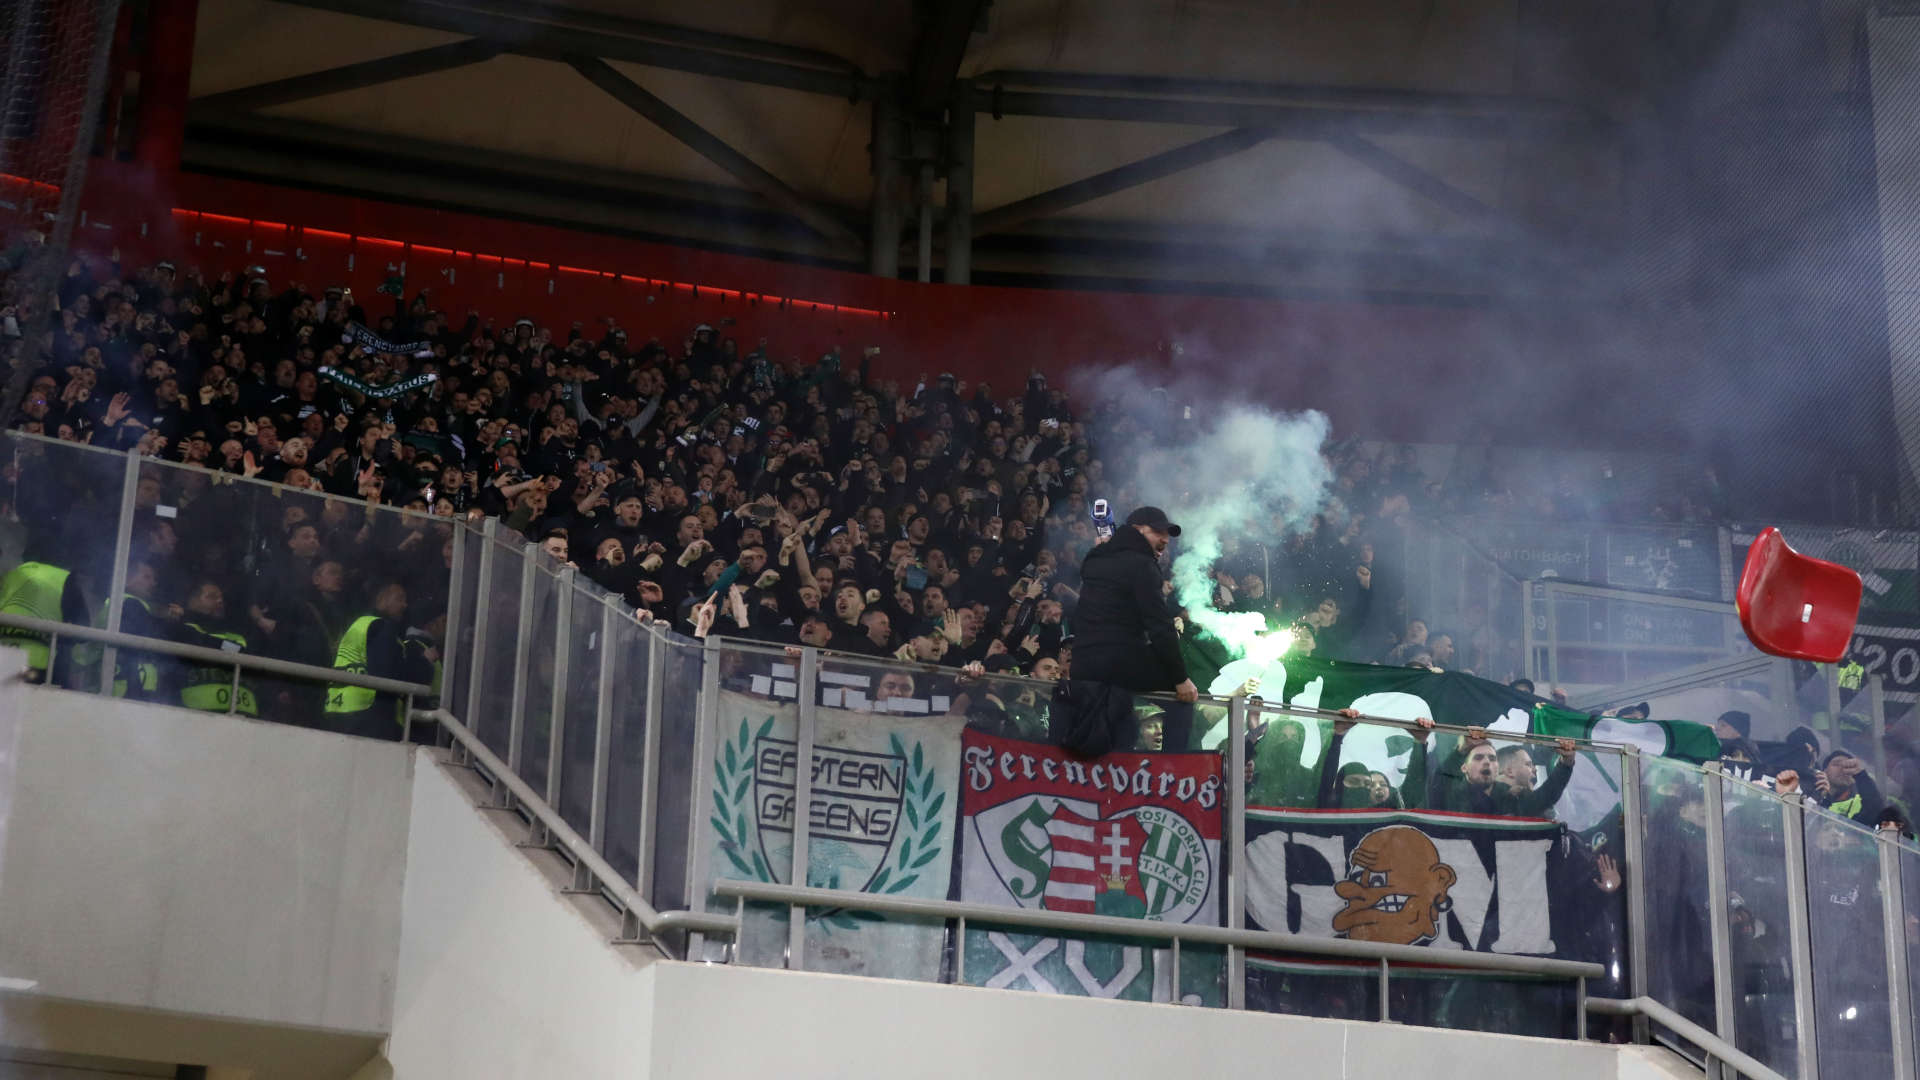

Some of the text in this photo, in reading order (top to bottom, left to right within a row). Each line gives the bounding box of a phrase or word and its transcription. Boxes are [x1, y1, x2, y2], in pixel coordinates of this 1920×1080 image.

[964, 745, 1221, 809] Ferencváros
[1171, 818, 1202, 864] TORNA
[1185, 870, 1204, 905] CLUB
